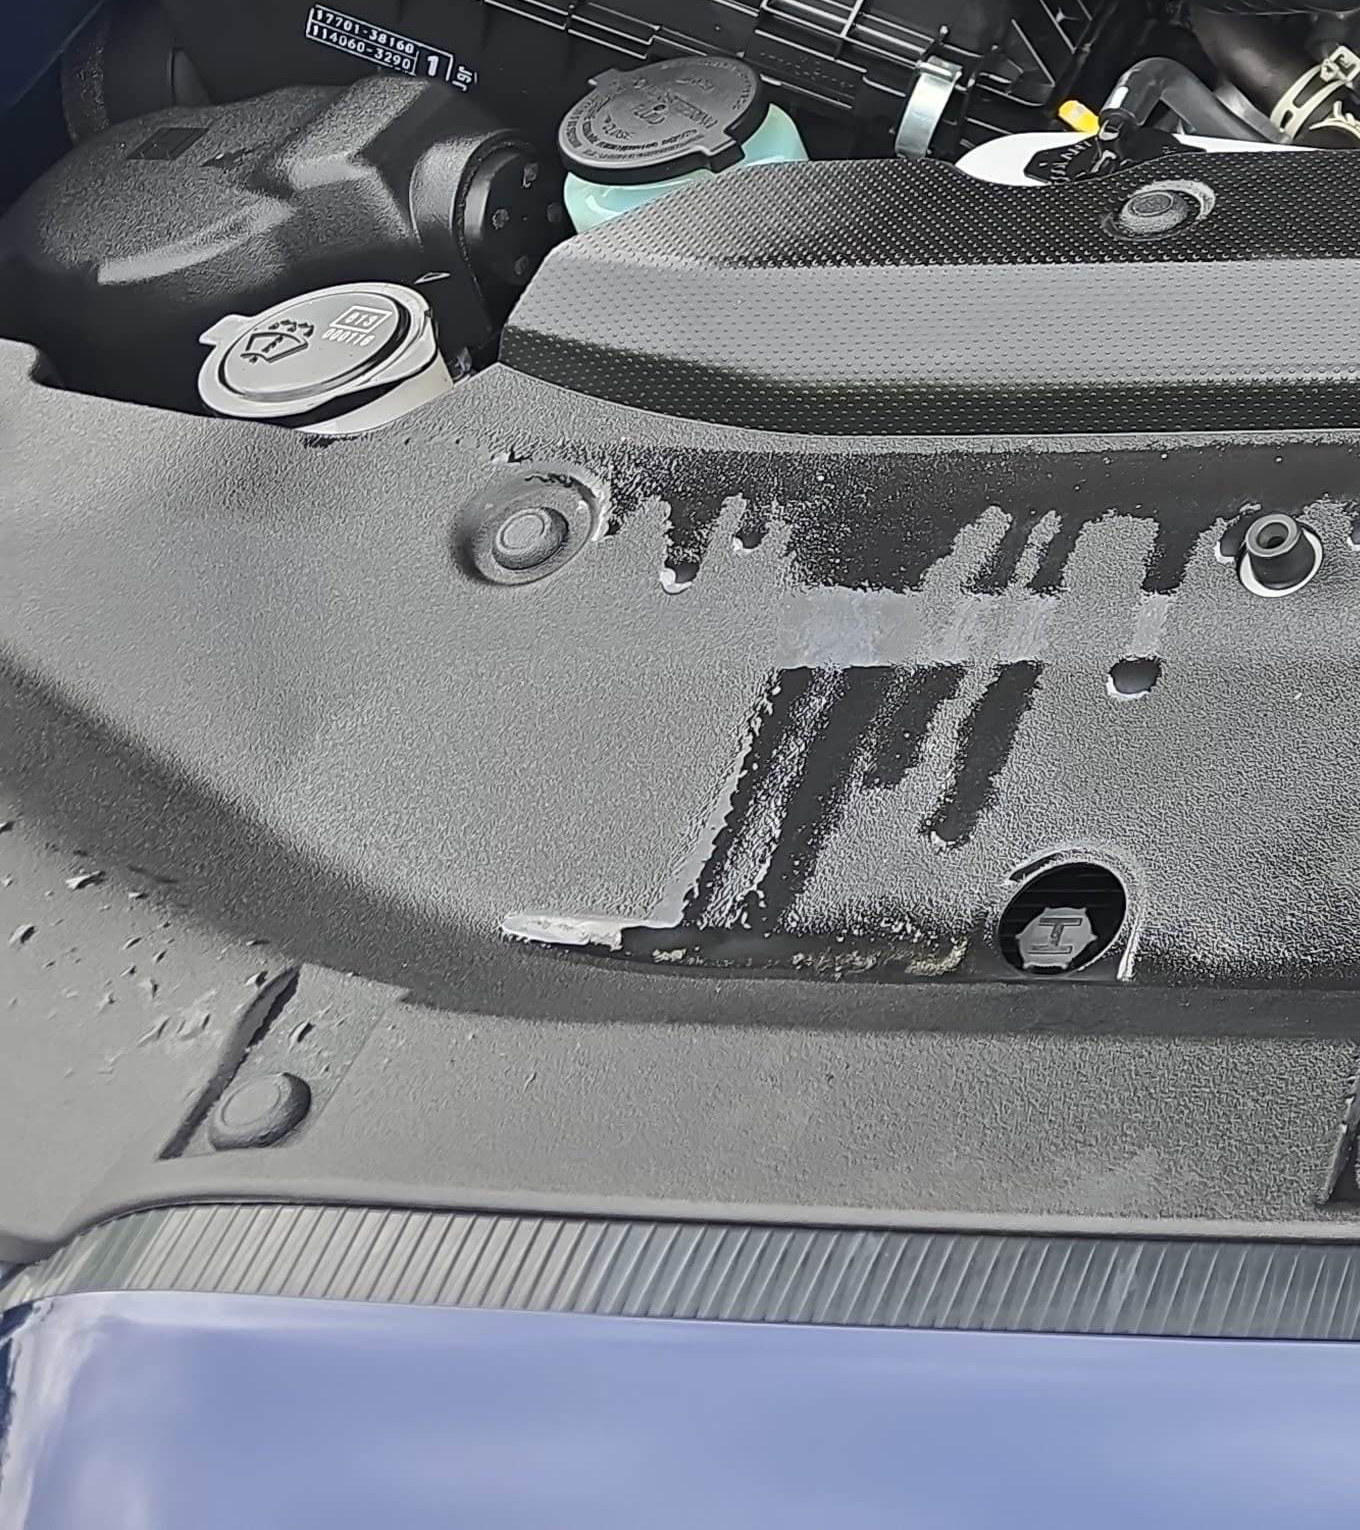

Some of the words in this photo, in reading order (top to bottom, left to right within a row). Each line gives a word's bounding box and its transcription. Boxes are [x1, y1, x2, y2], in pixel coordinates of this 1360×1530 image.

[311, 24, 412, 71] 114060-3290
[427, 54, 440, 77] 1
[315, 8, 416, 55] 17701-38160
